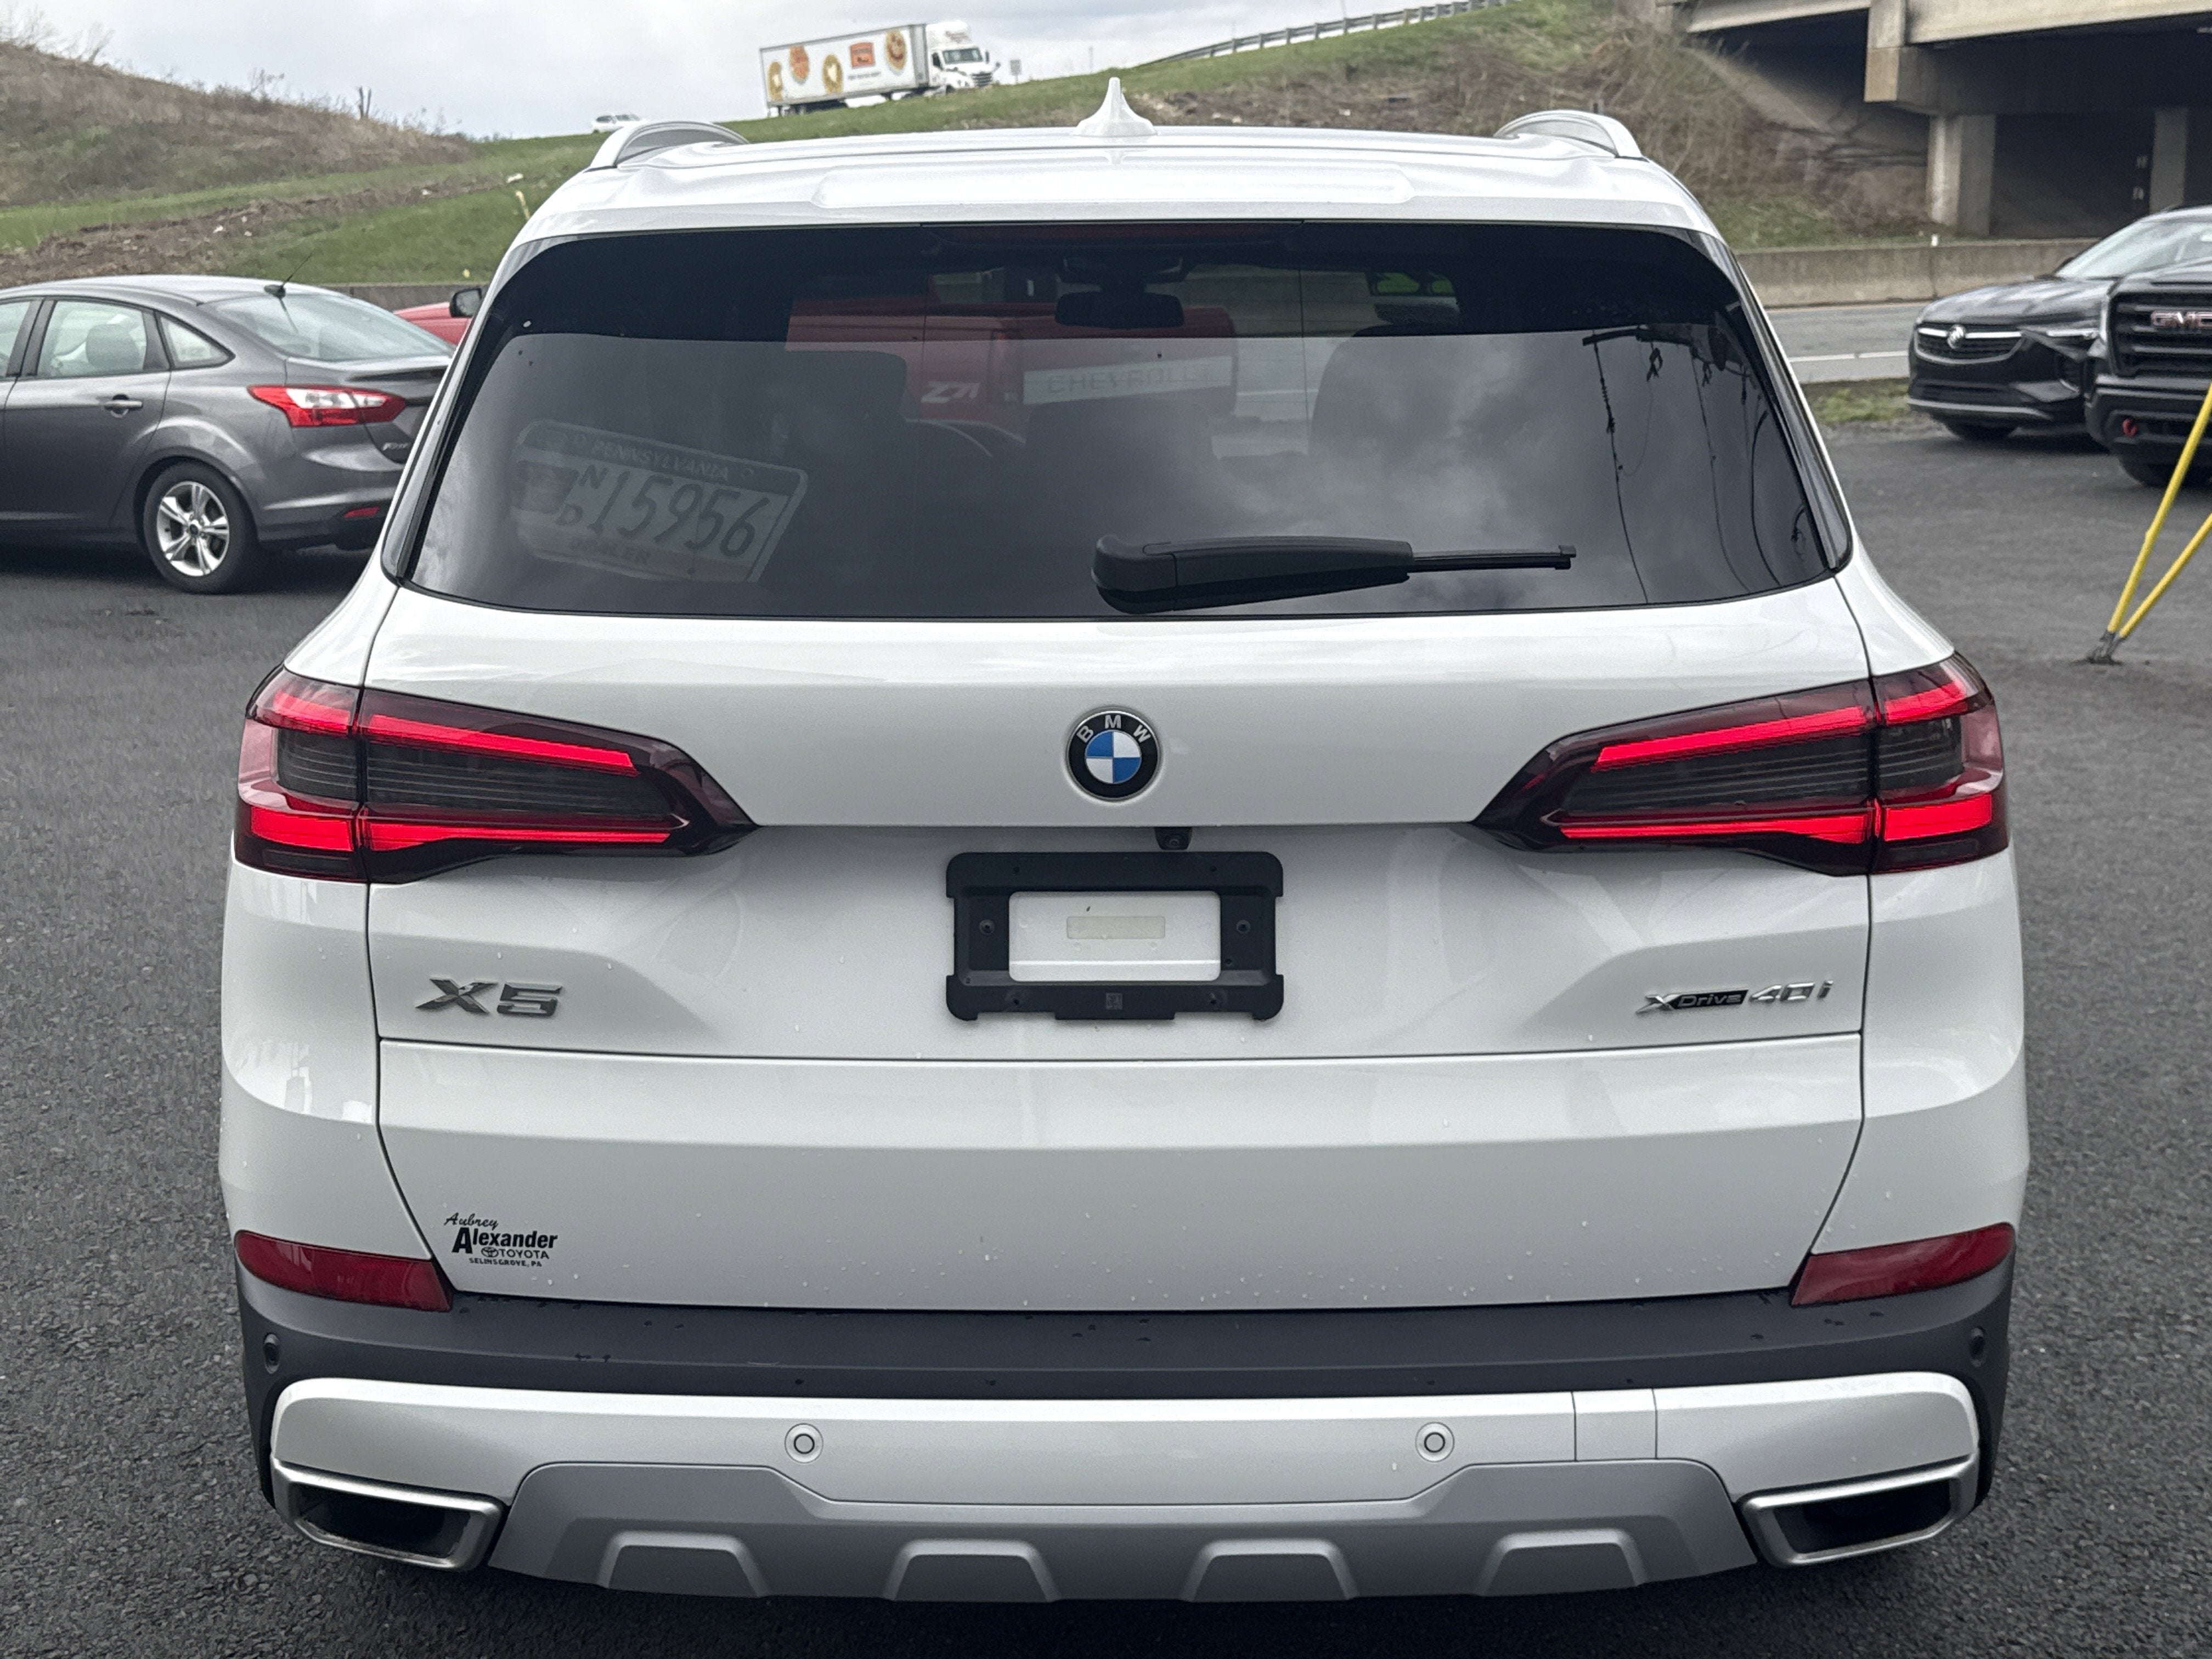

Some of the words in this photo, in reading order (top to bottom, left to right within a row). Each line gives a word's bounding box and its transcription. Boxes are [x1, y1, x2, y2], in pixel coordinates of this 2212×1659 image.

[592, 441, 730, 482] PENNSYLVANIA
[588, 471, 770, 557] 15956
[1076, 714, 1151, 743] BMW
[415, 978, 563, 1016] X5
[443, 1212, 498, 1231] Aubrey
[452, 1227, 558, 1254] Alexander
[498, 1249, 550, 1260] TOYOTA
